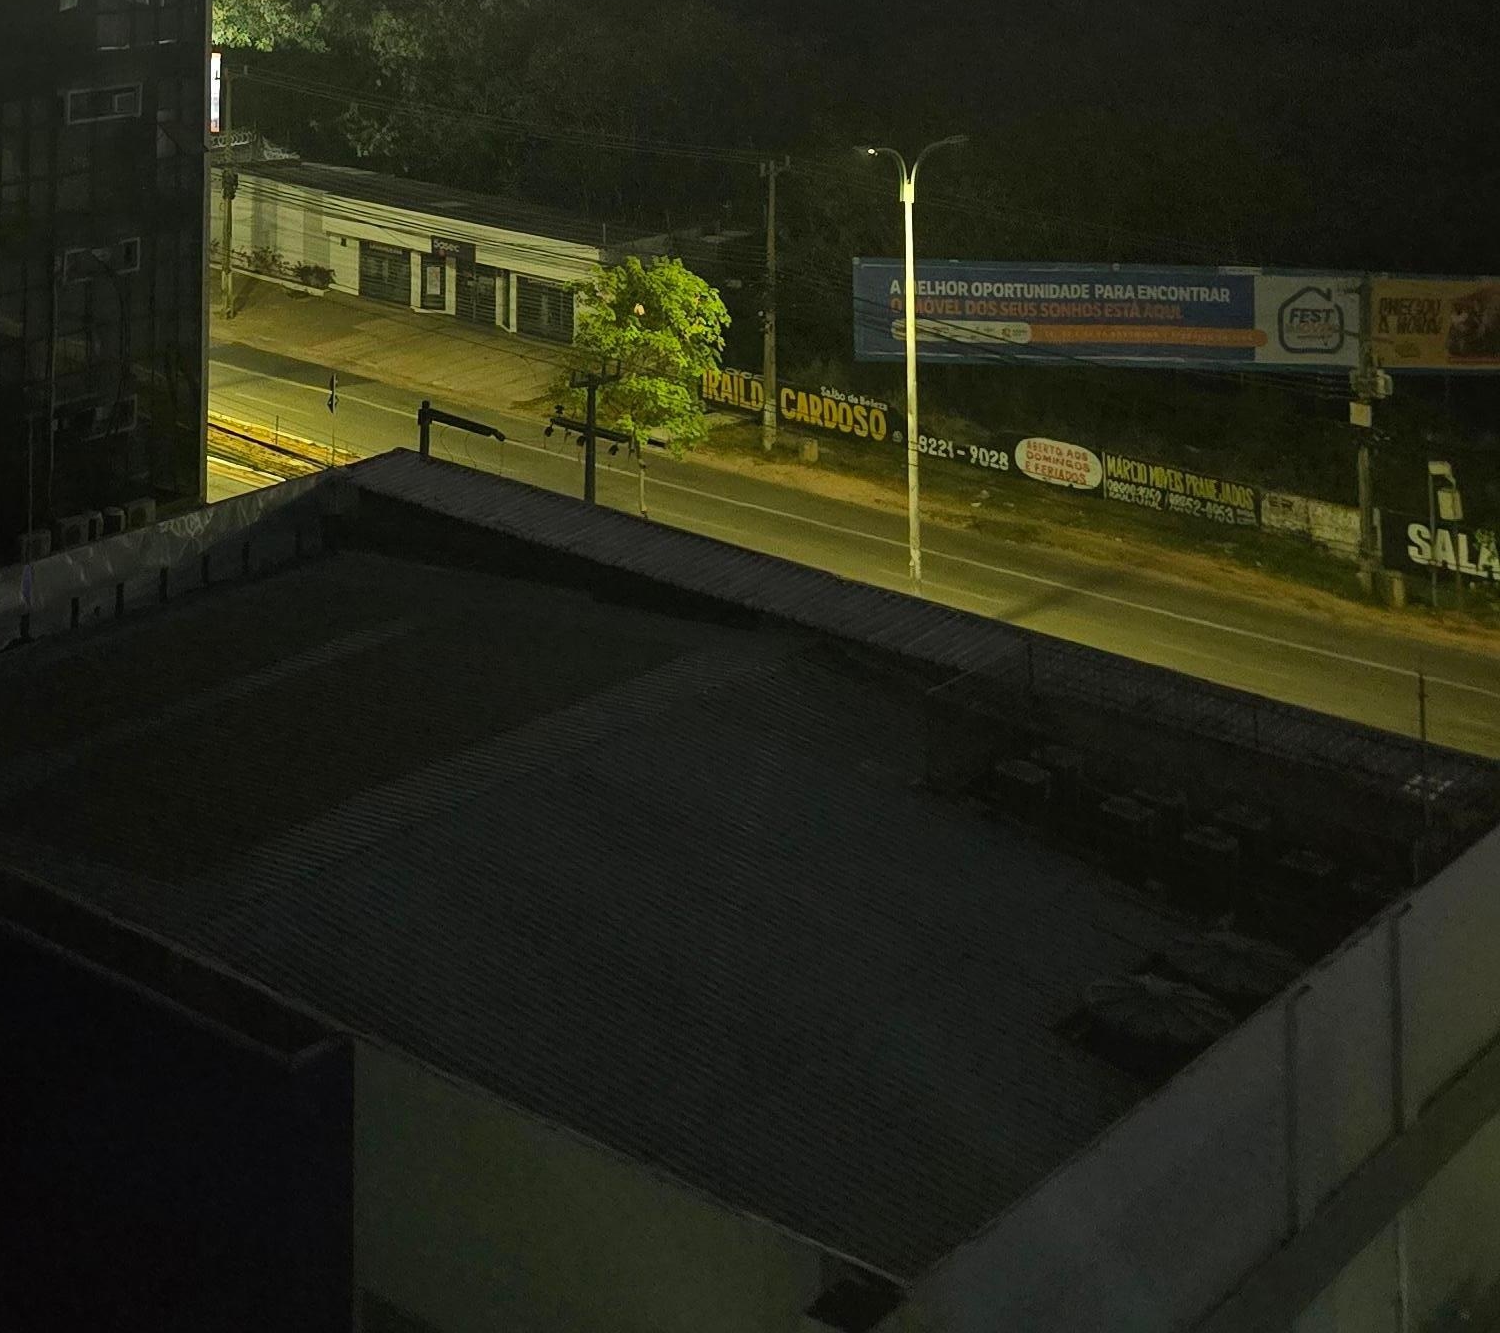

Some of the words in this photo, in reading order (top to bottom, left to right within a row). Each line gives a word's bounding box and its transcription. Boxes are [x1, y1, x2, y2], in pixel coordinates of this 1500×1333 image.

[890, 279, 902, 295] A
[970, 282, 1090, 299] OPORTUNIDADE
[1094, 285, 1135, 300] PARA
[1137, 286, 1231, 303] ENCONTRAR
[890, 297, 901, 314] O
[914, 296, 961, 315] MÓVEL
[964, 300, 1000, 317] DOS
[1001, 300, 1038, 318] SEUS
[1040, 301, 1102, 318] SONHOS
[1104, 301, 1140, 318] ESTÁ
[1290, 308, 1334, 323] FEST
[780, 387, 887, 442] CARDOSO
[1026, 440, 1063, 456] ABERTO
[1066, 448, 1089, 462] AOS
[1026, 451, 1090, 473] DOMINGOS
[1025, 461, 1031, 470] E
[1034, 462, 1087, 485] FERIADOS
